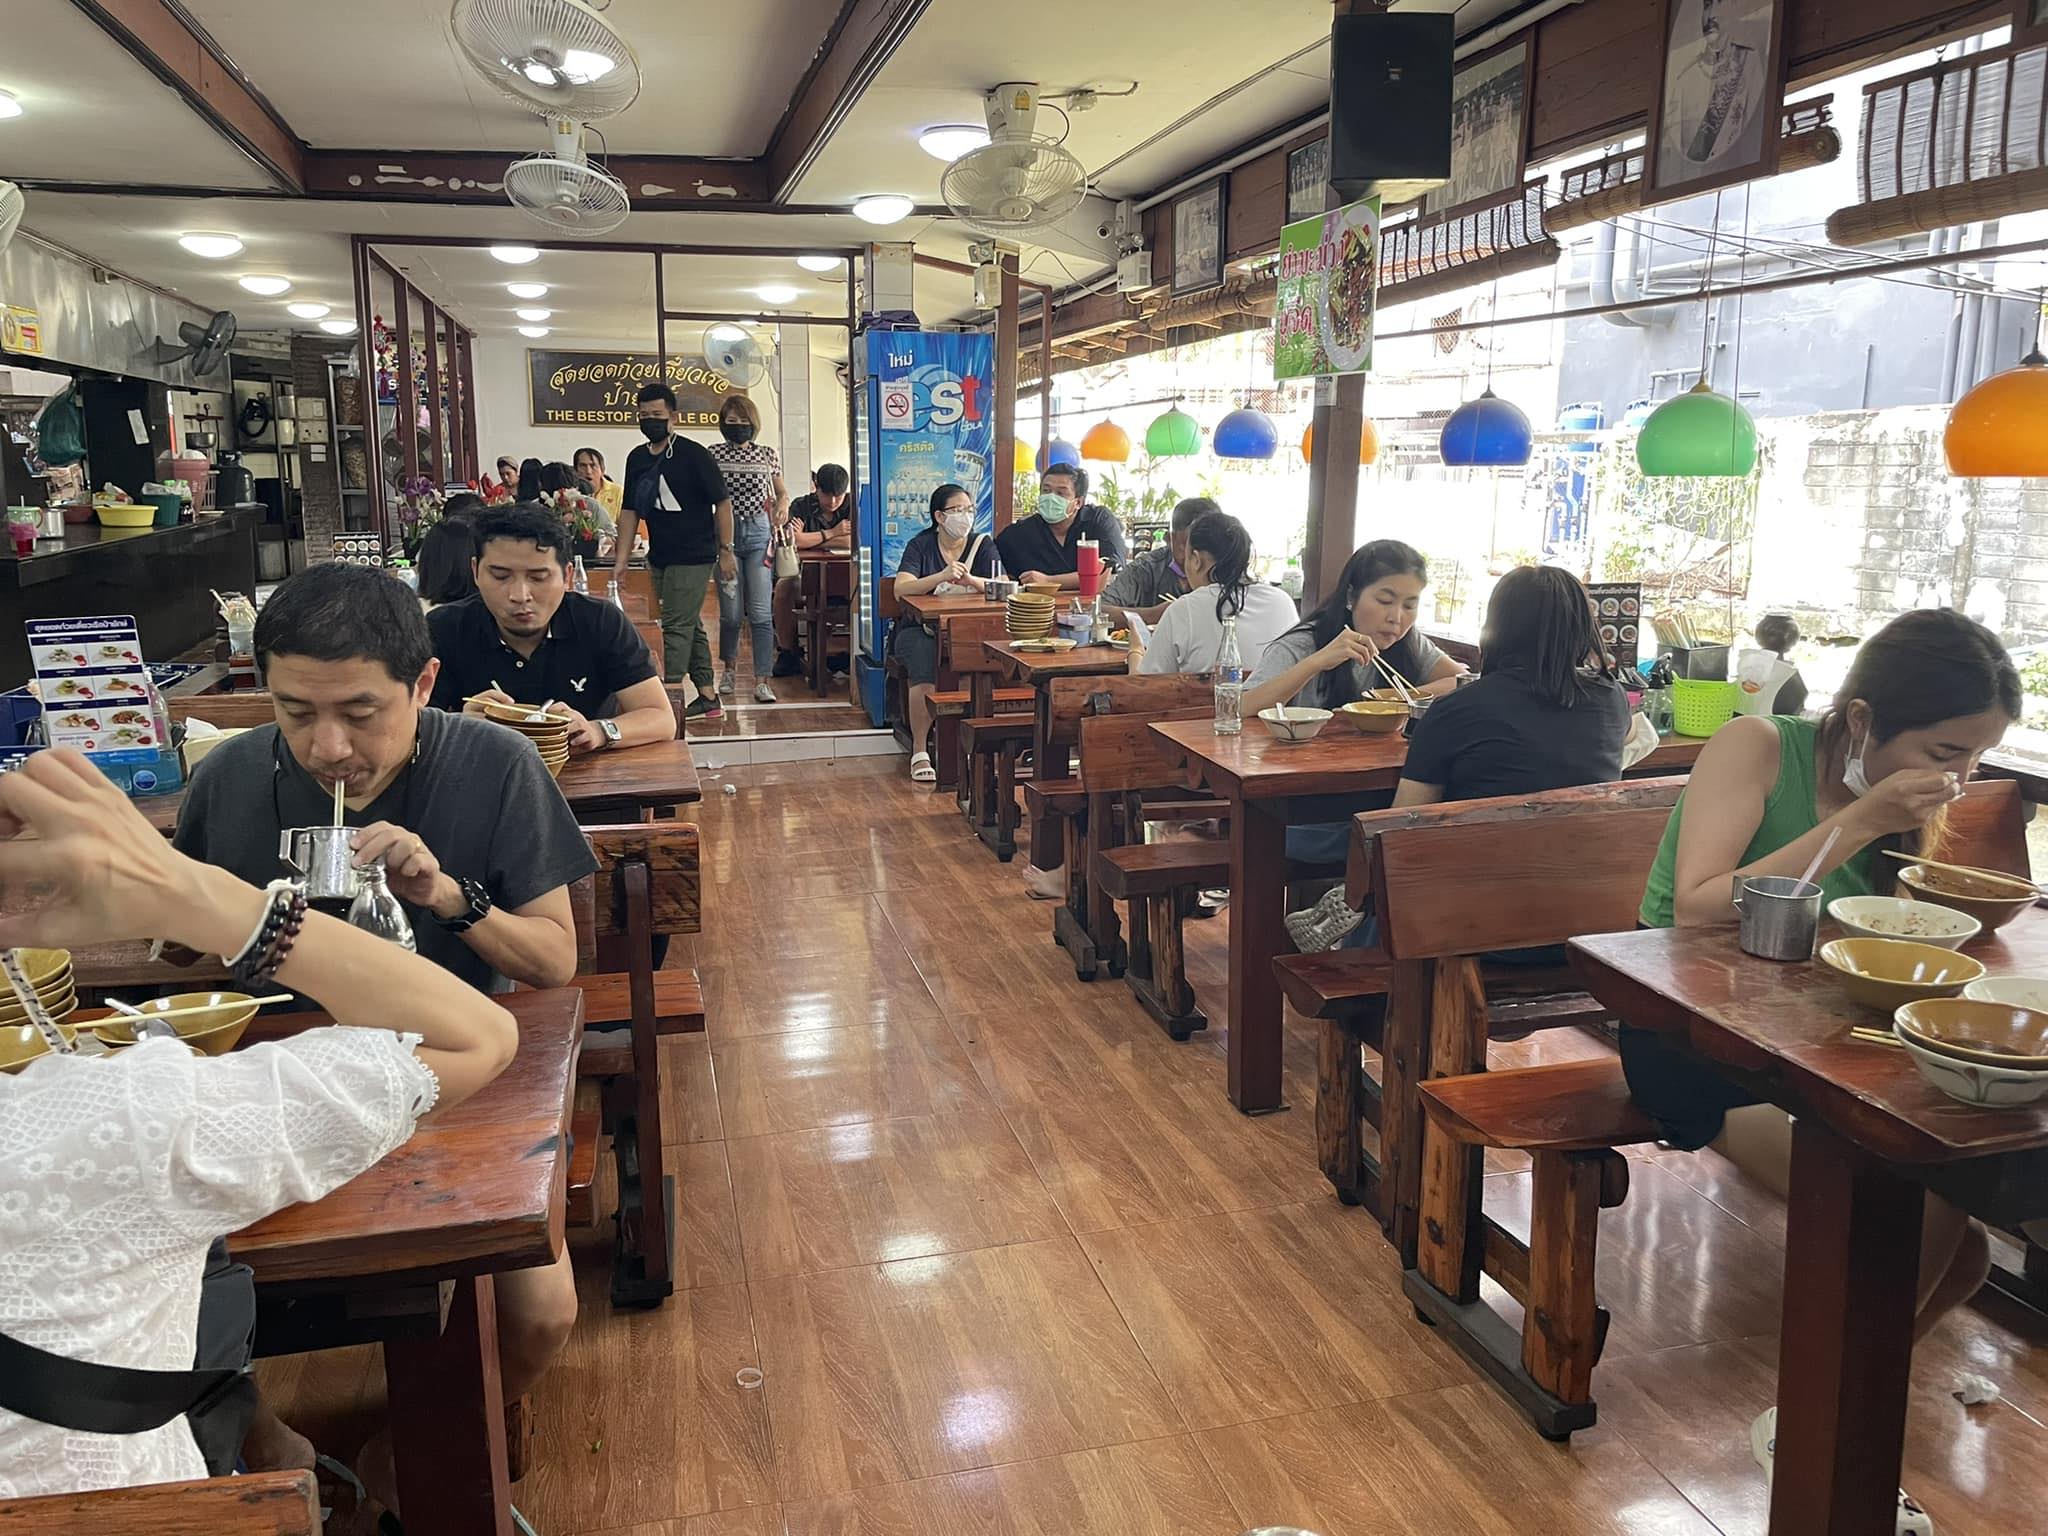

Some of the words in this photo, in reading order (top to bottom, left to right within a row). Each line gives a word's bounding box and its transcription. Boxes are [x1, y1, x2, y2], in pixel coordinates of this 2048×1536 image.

[888, 350, 913, 368] ใหม่
[546, 410, 572, 421] THE
[578, 410, 632, 422] BESTOF
[699, 413, 720, 424] BO
